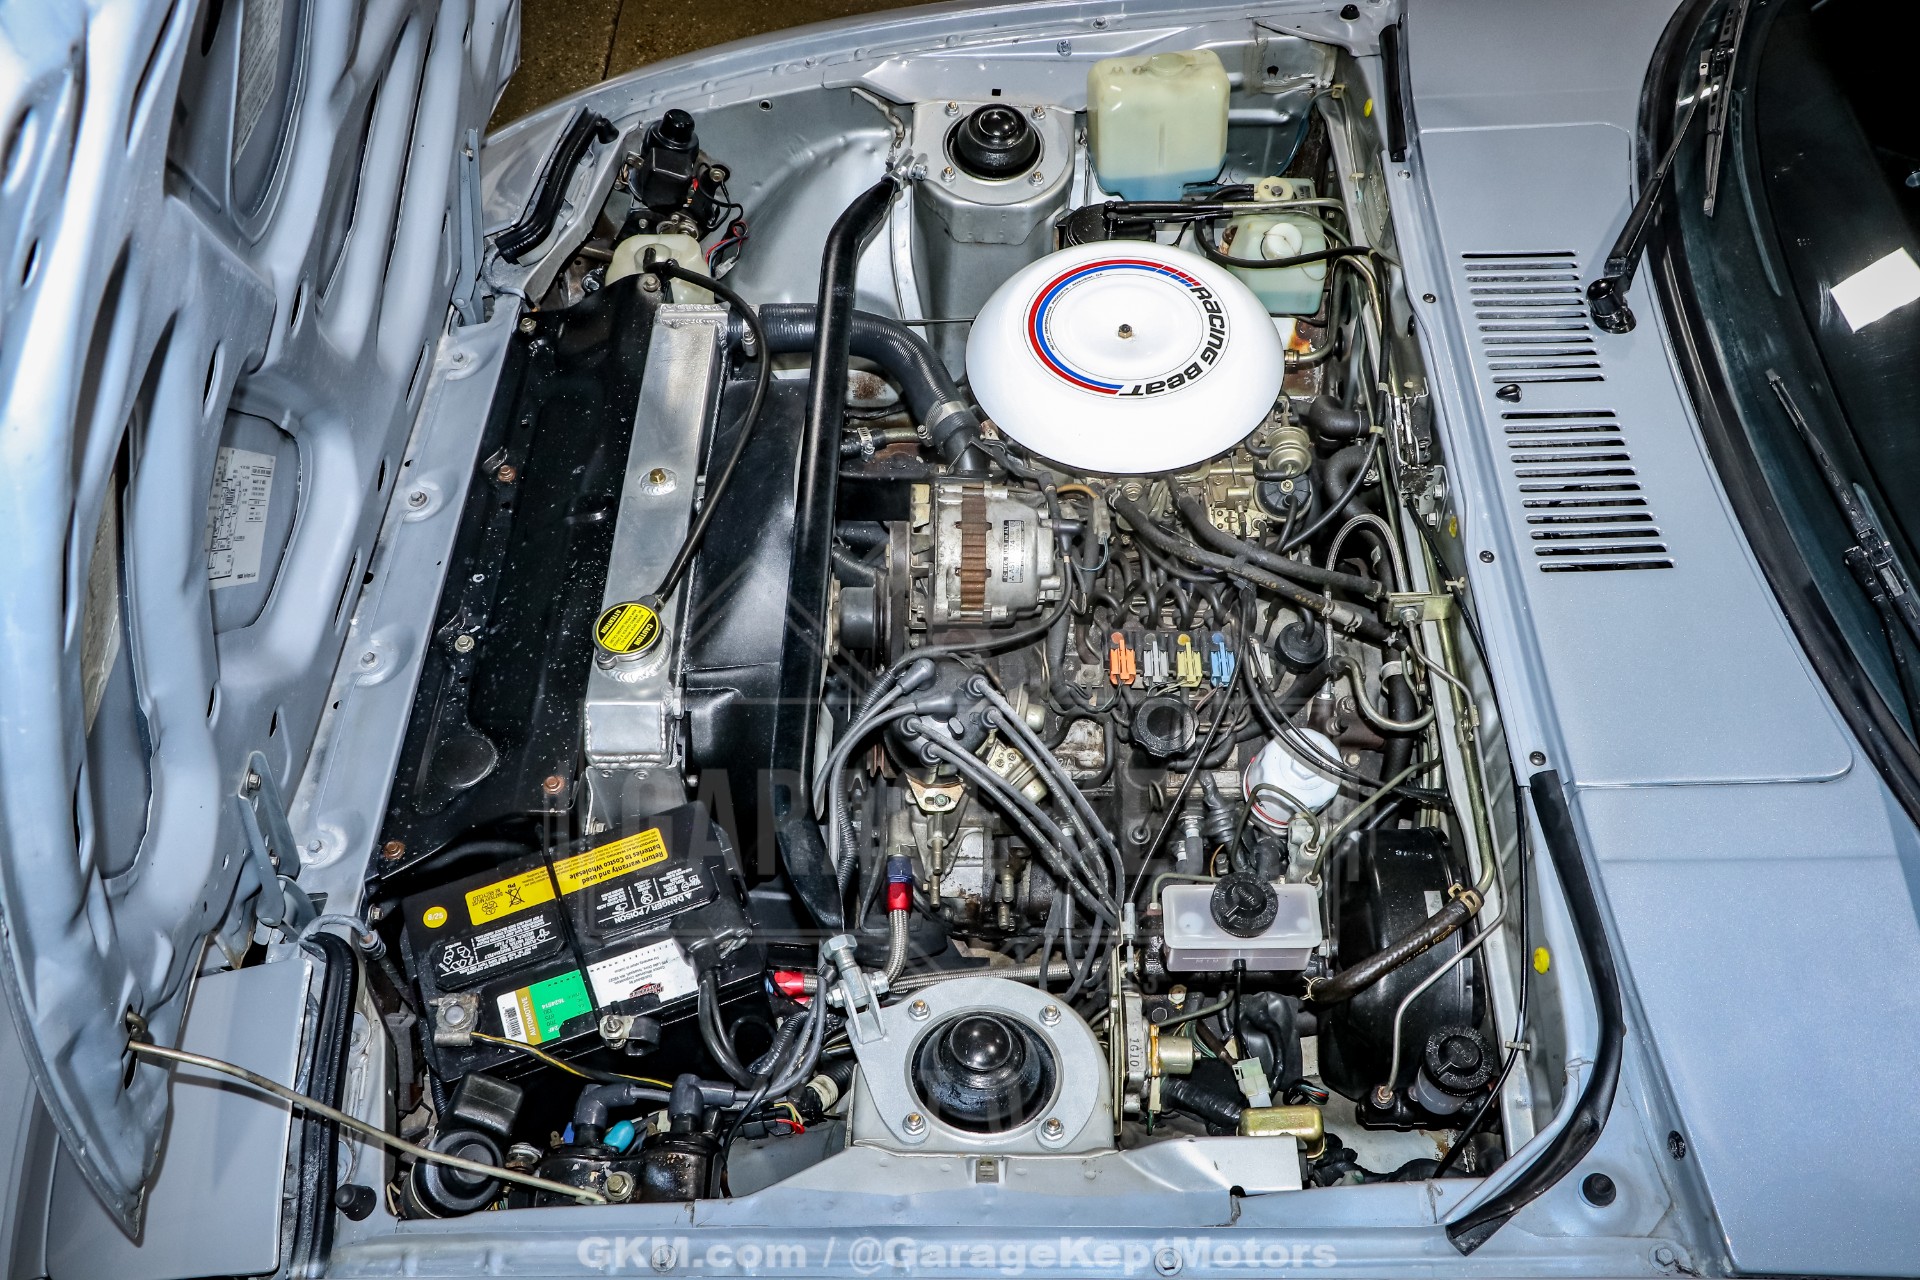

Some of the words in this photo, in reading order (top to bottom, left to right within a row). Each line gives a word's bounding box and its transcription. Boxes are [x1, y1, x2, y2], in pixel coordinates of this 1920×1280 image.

[599, 608, 622, 634] ATTENTION
[632, 622, 653, 646] CAUTION
[632, 843, 661, 858] batteries
[641, 851, 663, 863] Return
[602, 855, 624, 868] Costco
[611, 858, 640, 873] warranty
[568, 863, 603, 880] Wholesale
[581, 874, 598, 884] used
[597, 869, 611, 878] and
[650, 894, 684, 911] DANGER
[427, 910, 444, 922] 8/25
[613, 908, 644, 924] POISON
[521, 997, 537, 1036] AUTOMOTIVE
